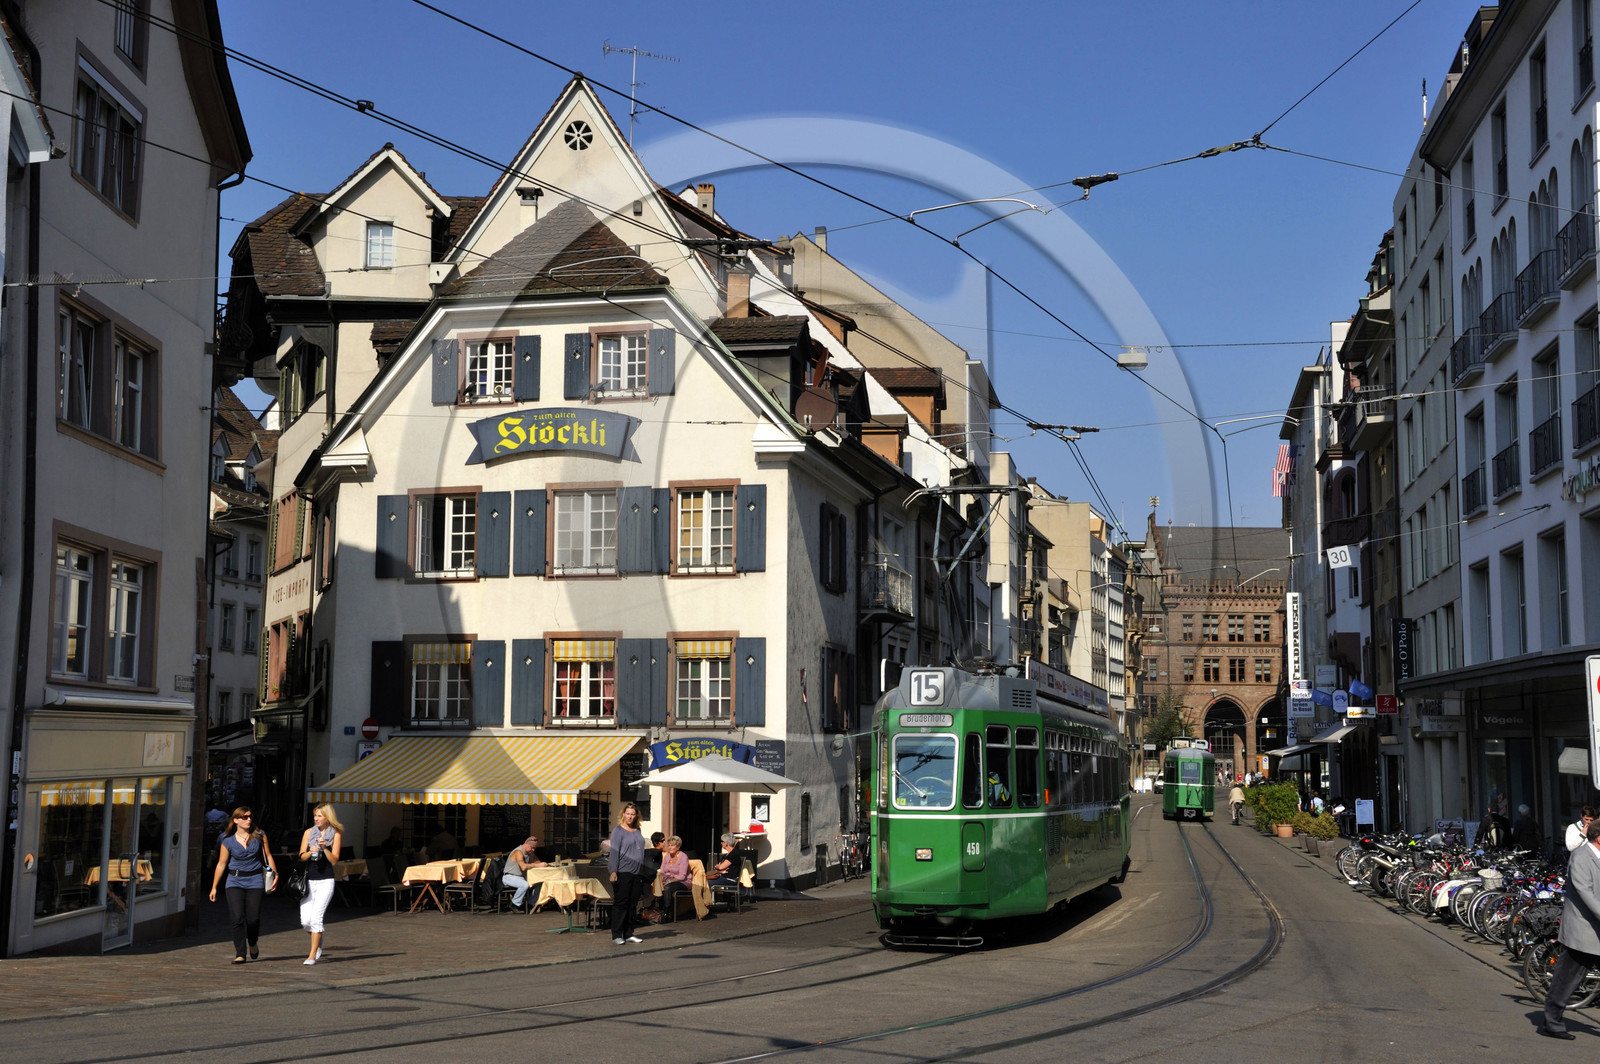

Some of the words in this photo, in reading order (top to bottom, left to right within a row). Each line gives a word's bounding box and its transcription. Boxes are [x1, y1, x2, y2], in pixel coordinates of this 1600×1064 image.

[494, 416, 607, 454] Stöckli
[1330, 550, 1348, 564] 30
[1292, 595, 1300, 681] FELDPAUSCH
[914, 674, 941, 702] 15
[906, 714, 946, 723] Bruderholz
[1483, 716, 1524, 725] Vögele
[966, 842, 980, 855] 458
